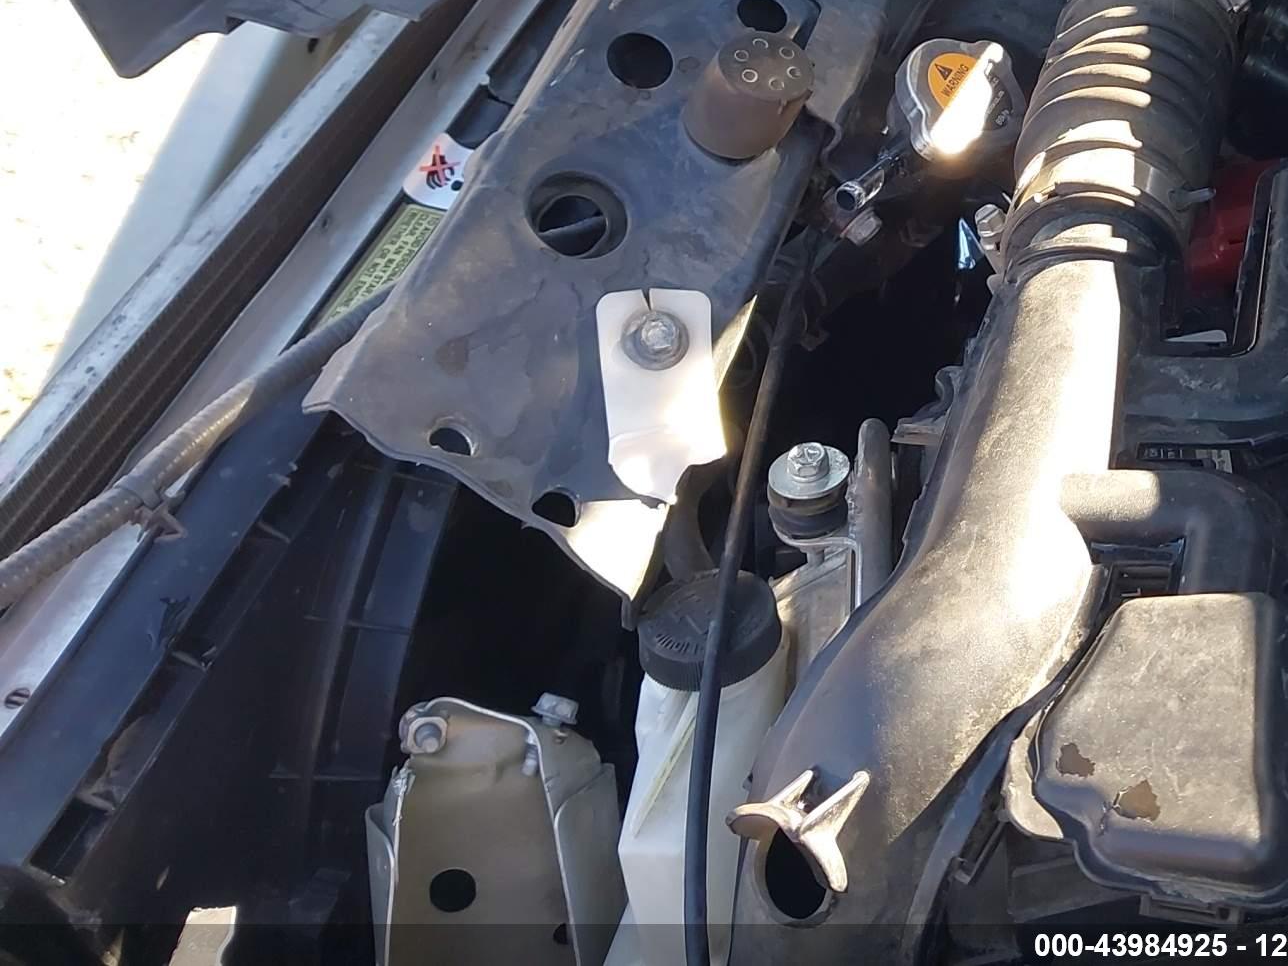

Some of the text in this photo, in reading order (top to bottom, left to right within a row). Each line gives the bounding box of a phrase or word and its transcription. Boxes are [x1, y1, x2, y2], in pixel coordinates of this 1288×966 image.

[940, 62, 969, 98] WARNING
[387, 211, 418, 245] WHETHER
[410, 227, 430, 247] AVOID
[392, 240, 408, 255] FAN
[363, 261, 380, 276] NOT
[378, 258, 395, 273] MAY
